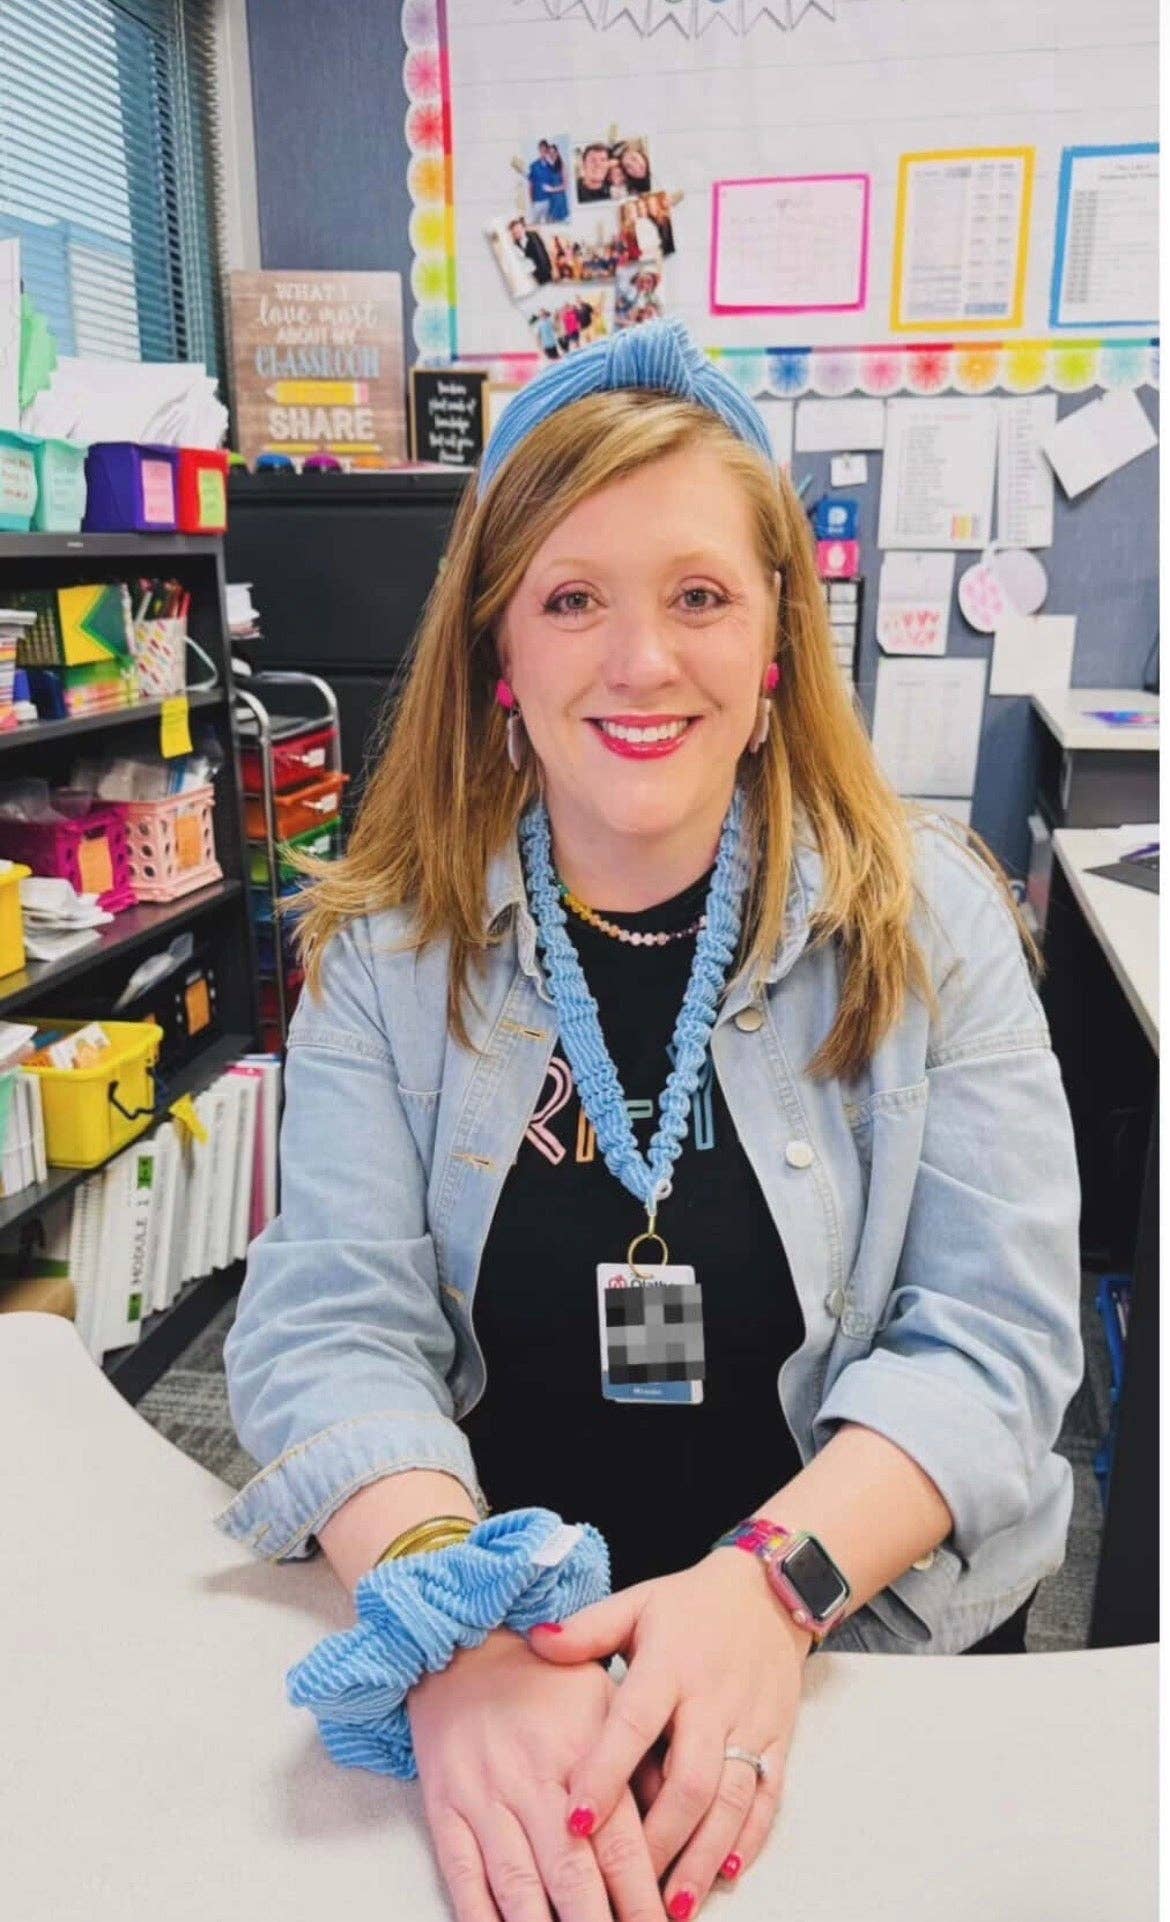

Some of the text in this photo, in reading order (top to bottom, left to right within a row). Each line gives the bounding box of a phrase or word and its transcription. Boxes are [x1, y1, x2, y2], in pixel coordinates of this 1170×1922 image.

[274, 282, 333, 300] WHAT
[257, 295, 378, 327] love most
[268, 406, 376, 441] SHARE
[131, 1217, 147, 1286] MODULE
